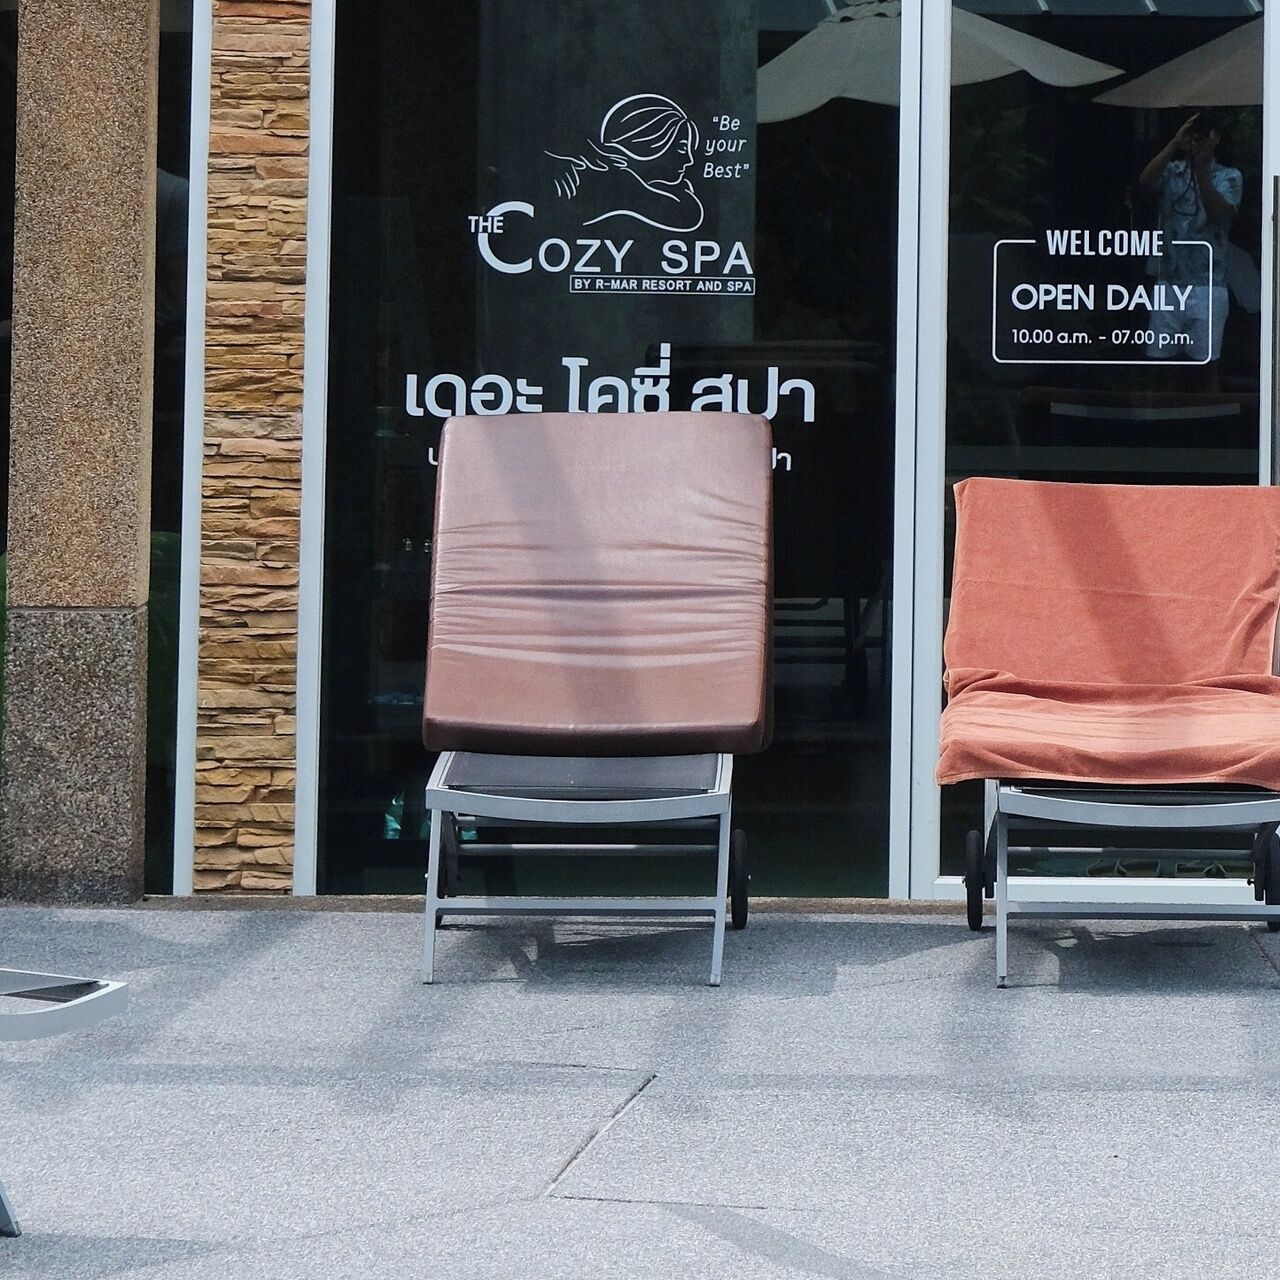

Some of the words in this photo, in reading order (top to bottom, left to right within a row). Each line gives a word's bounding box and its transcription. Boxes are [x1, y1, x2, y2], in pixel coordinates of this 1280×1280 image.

[704, 137, 748, 155] your
[467, 215, 505, 234] THE
[477, 200, 635, 275] COZY
[1045, 229, 1164, 257] WELCOME
[660, 240, 755, 275] SPA
[573, 278, 590, 290] BY
[595, 278, 639, 291] R-MAR
[642, 279, 693, 292] RESORT
[696, 280, 724, 292] AND
[726, 281, 753, 293] SPA
[1011, 283, 1095, 311] OPEN
[1106, 284, 1193, 312] DAILY
[1011, 328, 1053, 345] 10.00
[1057, 330, 1092, 345] a.m.
[1111, 329, 1155, 345] 07.00
[1158, 332, 1194, 350] p.m.
[405, 373, 544, 417] เดอะ
[561, 342, 671, 414] โคซี่
[690, 366, 816, 423] สปา
